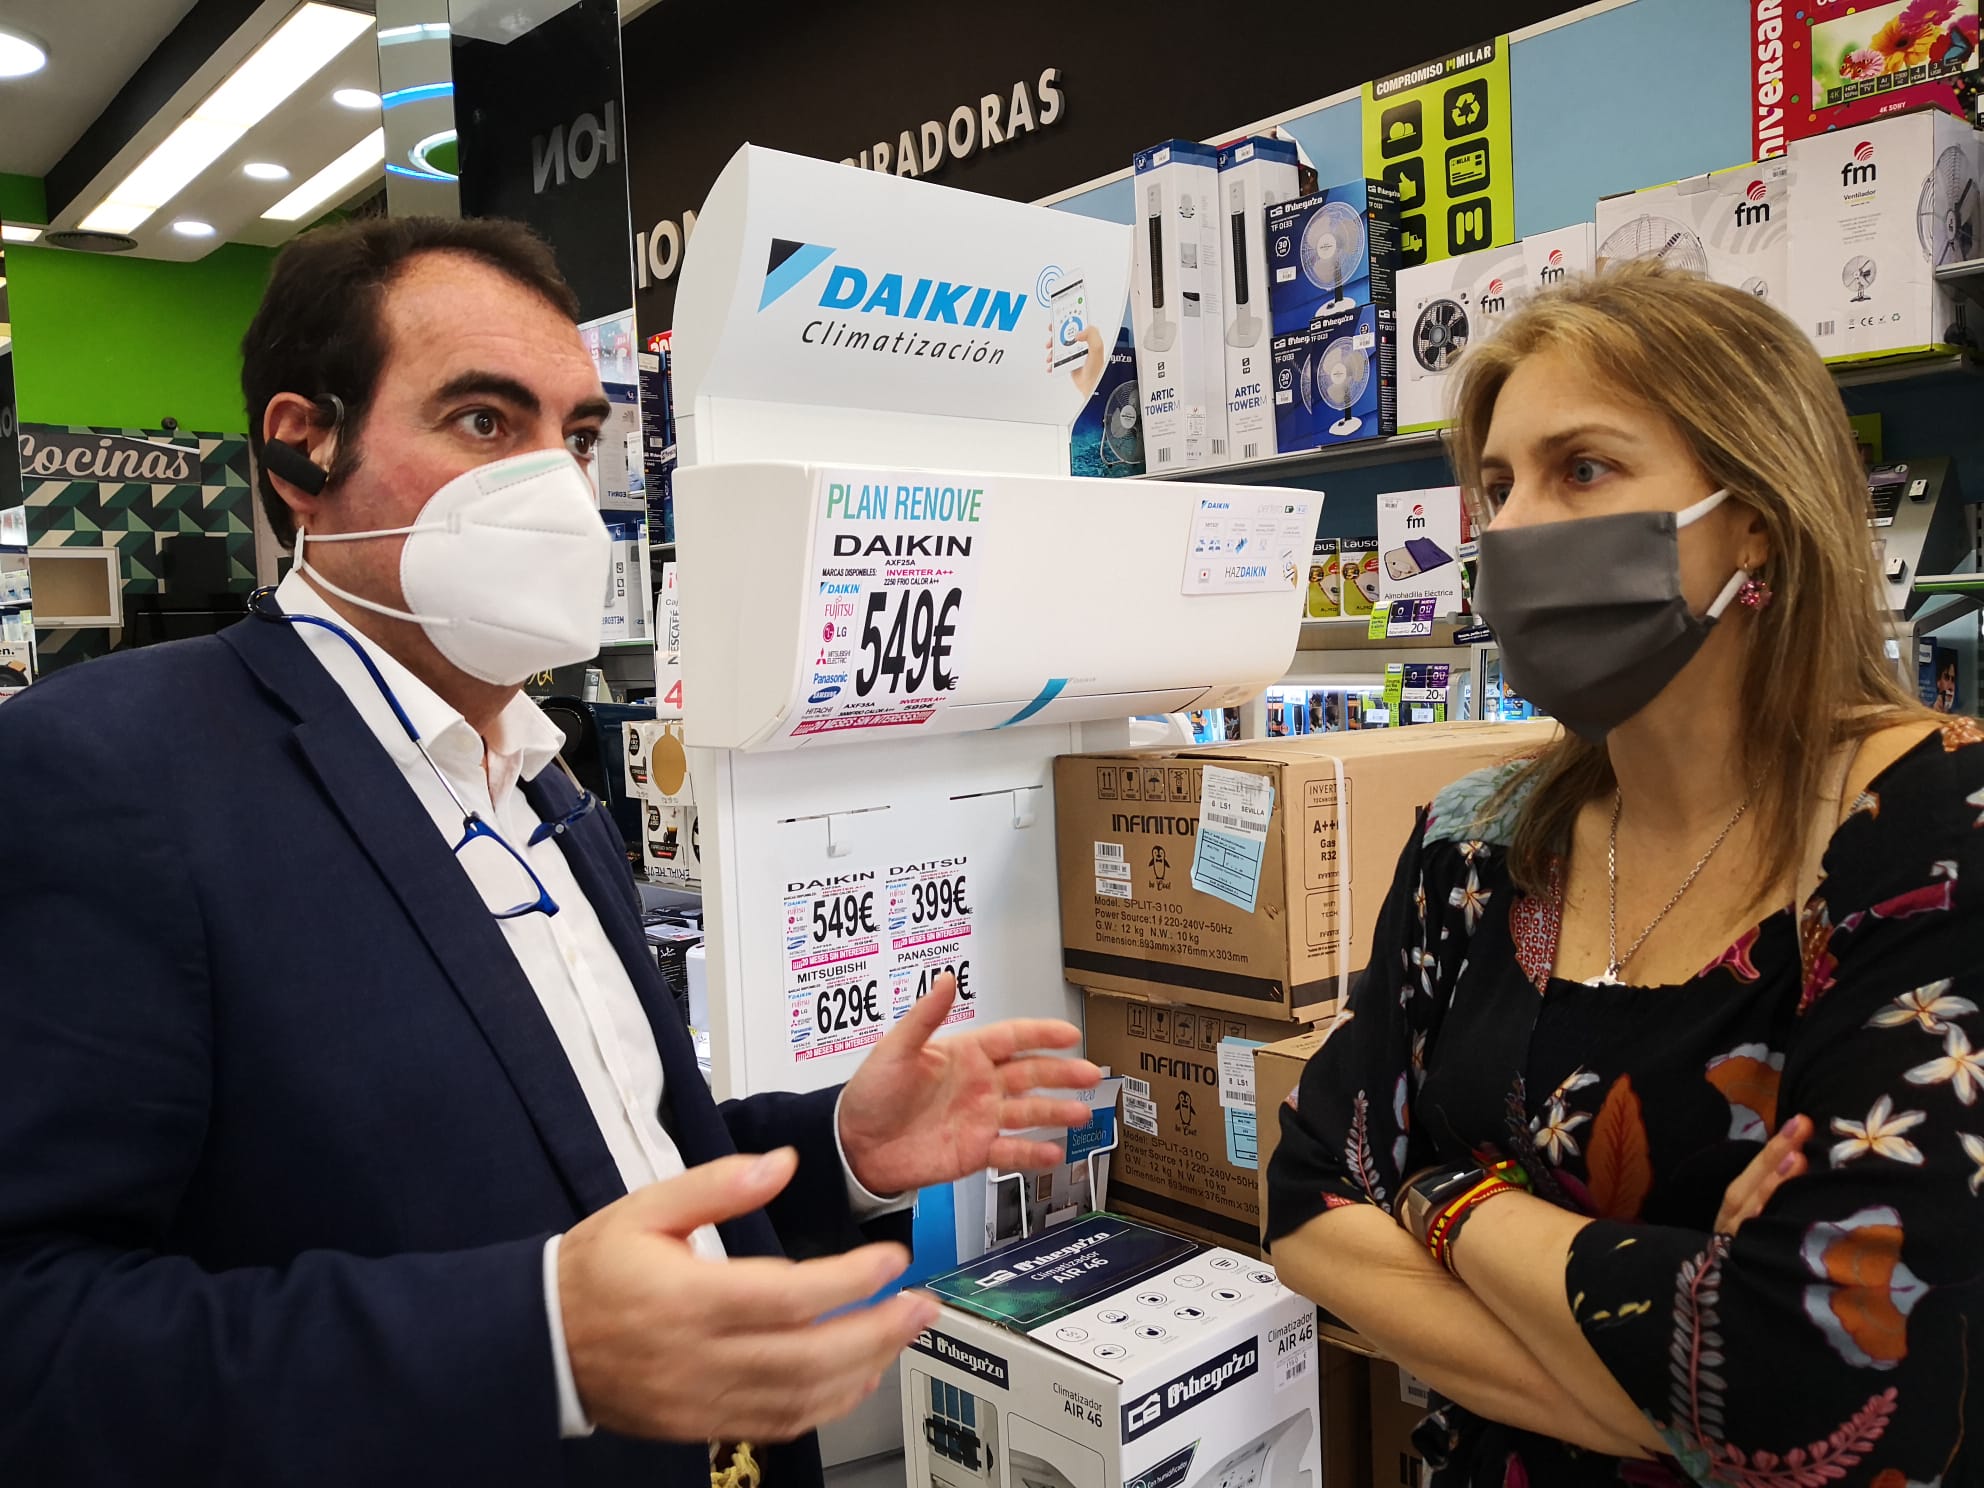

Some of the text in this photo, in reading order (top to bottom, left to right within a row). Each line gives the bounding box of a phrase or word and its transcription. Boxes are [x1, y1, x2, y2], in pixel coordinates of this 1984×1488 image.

[1376, 45, 1492, 96] COMPROMISO MILAR
[838, 67, 1065, 179] RADORAS
[1841, 161, 1877, 187] fm
[1843, 189, 1876, 201] Ventilador
[1734, 201, 1771, 228] fm
[1278, 240, 1288, 249] 30
[1541, 265, 1566, 287] fm
[818, 265, 1029, 333] DAIKIN
[1480, 293, 1505, 315] fm
[800, 320, 1005, 366] Climatización
[1281, 372, 1290, 382] 30
[1150, 388, 1175, 403] ARTIC
[1234, 383, 1261, 399] ARTIC
[826, 483, 984, 522] PLAN RENOVE
[1207, 502, 1231, 510] DAIKIN
[1406, 515, 1426, 530] fm
[833, 534, 972, 557] DAIKIN
[822, 568, 844, 577] MARCAS
[885, 559, 916, 567] AXF25A
[886, 568, 954, 576] INVERTER A++
[1224, 565, 1267, 579] HAZDAIKIN
[827, 583, 860, 594] DAIKIN
[897, 578, 909, 586] FRIO
[910, 578, 928, 586] CALOR
[1384, 590, 1423, 600] Almohadilla
[825, 600, 854, 620] FUJITSU
[836, 626, 848, 638] LG
[855, 588, 963, 697] 549€
[813, 671, 848, 685] Panasonic
[805, 706, 833, 715] HITACHI
[1241, 805, 1265, 817] SEVILLA
[1320, 839, 1336, 849] Gas
[889, 856, 967, 876] DAITSU
[1320, 850, 1337, 862] R32
[787, 870, 875, 893] DAIKIN
[911, 875, 967, 924] 399€
[1123, 899, 1183, 915] SPLIT-3100
[812, 891, 875, 943] 549€
[1095, 908, 1120, 921] Power
[1121, 924, 1131, 934] 12
[1134, 926, 1144, 938] kg
[1177, 931, 1188, 942] 10
[1189, 933, 1200, 946] kg
[897, 942, 960, 963] PANASONIC
[797, 960, 867, 984] MITSUBISHI
[817, 980, 879, 1034] 629€
[1072, 1130, 1107, 1147] Selección
[1123, 1141, 1148, 1156] Power
[1151, 1137, 1209, 1162] SPLIT-3100
[1150, 1160, 1227, 1195] 12 kg 10 kg
[1030, 1250, 1101, 1281] Climatizador
[1052, 1258, 1109, 1284] AIR 46
[1267, 1311, 1314, 1343] Climatizador
[1277, 1324, 1313, 1356] AIR 46
[1052, 1382, 1103, 1411] Climatizador
[1064, 1400, 1103, 1428] AIR 46
[1156, 1460, 1188, 1481] humidificador
